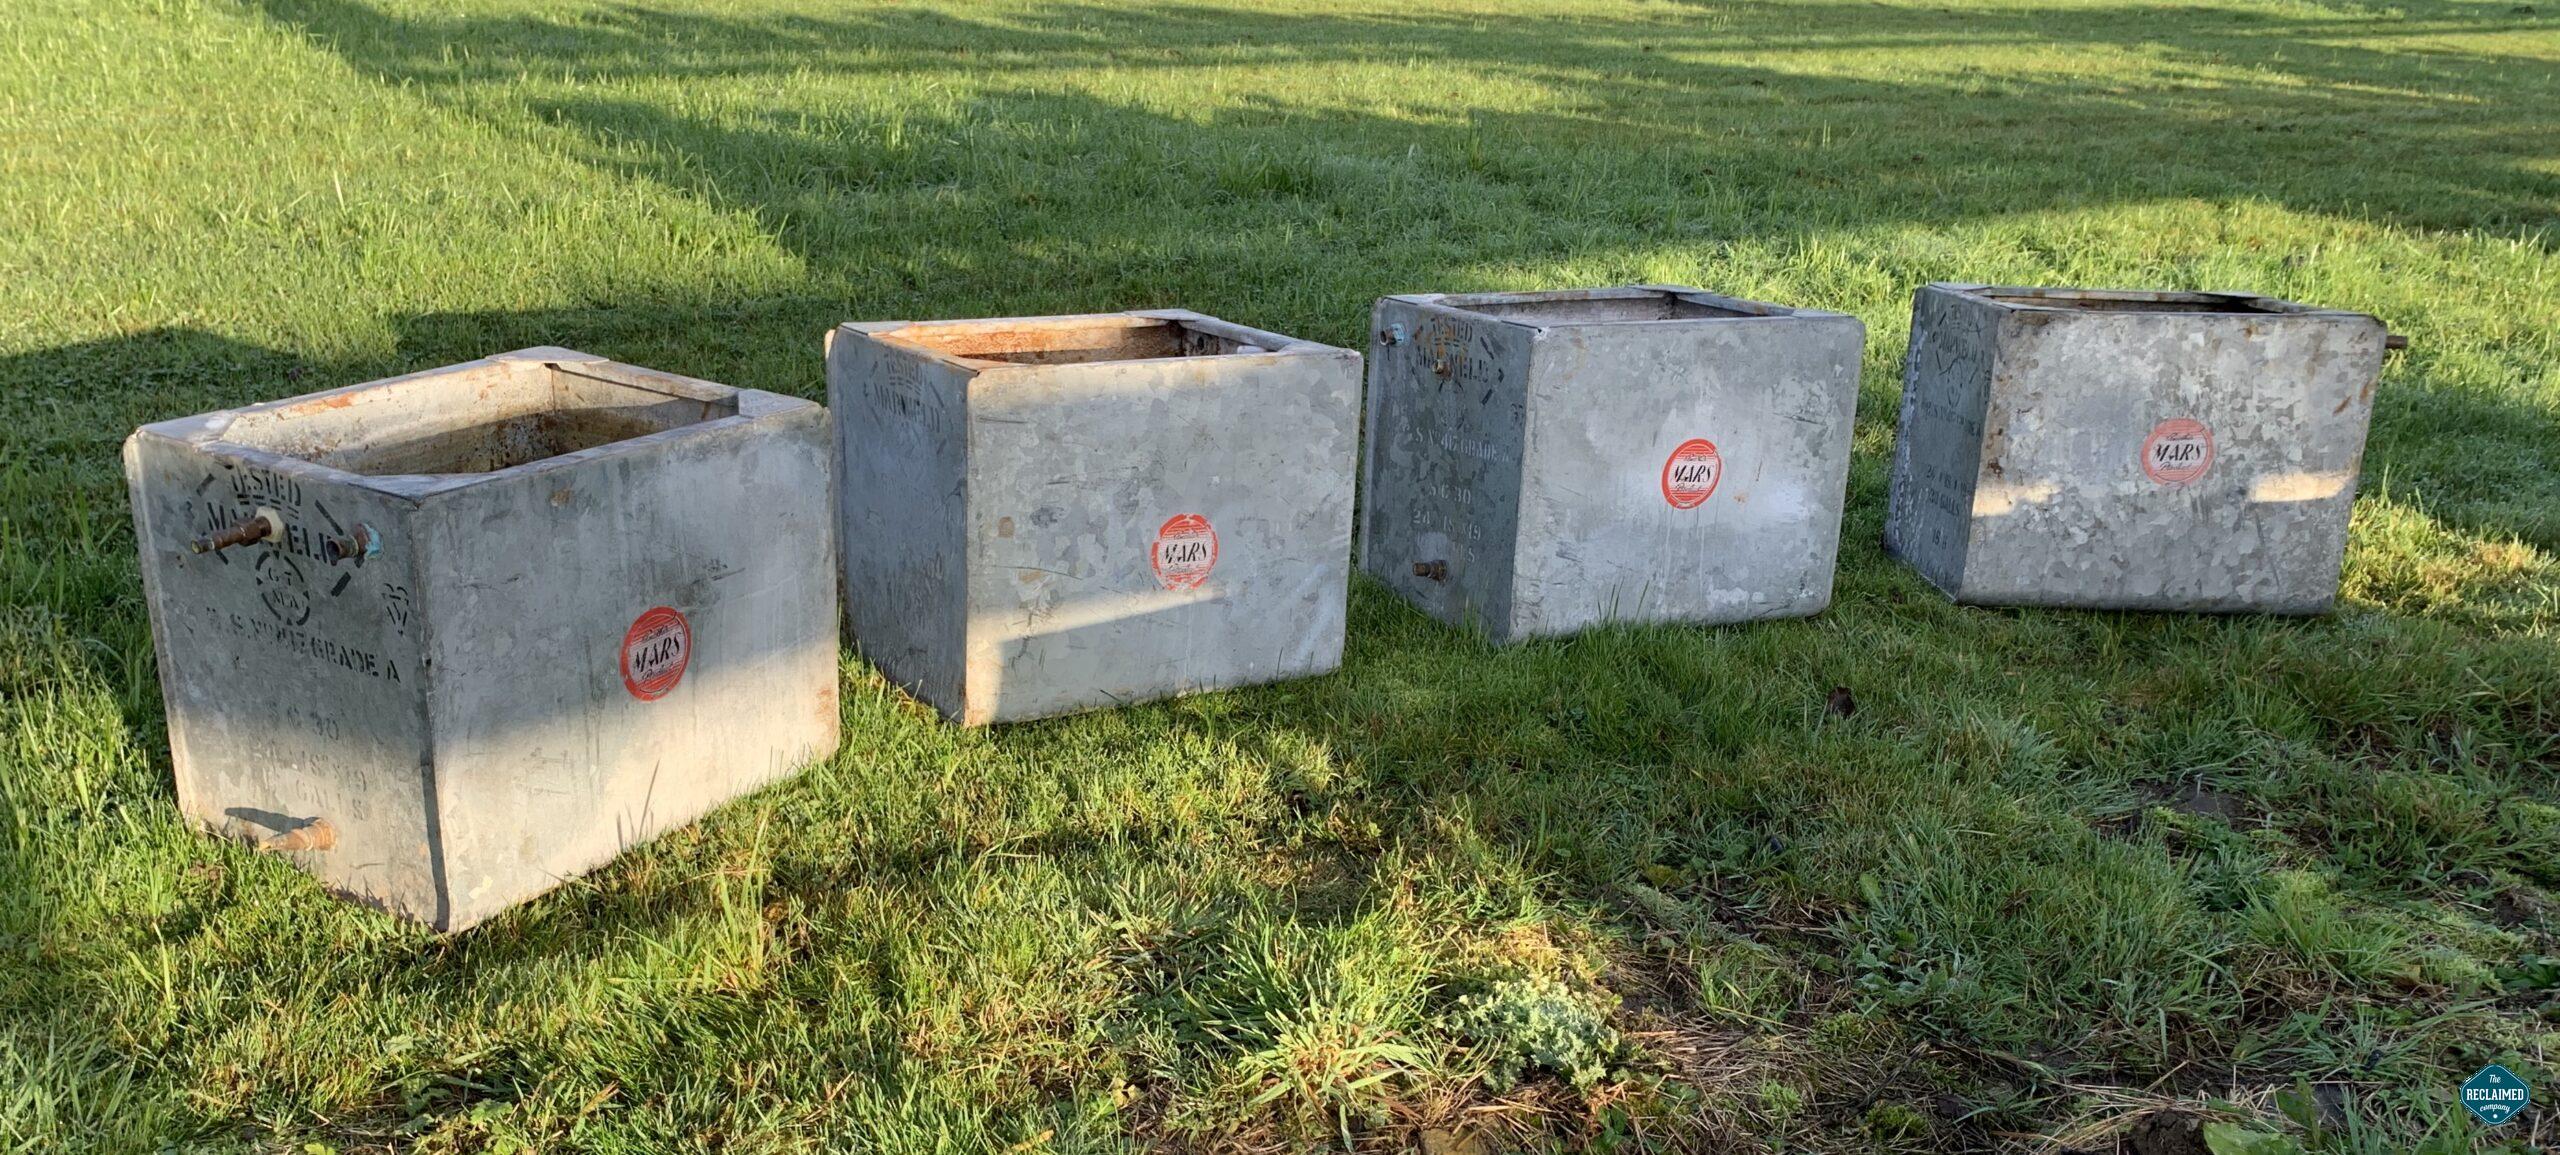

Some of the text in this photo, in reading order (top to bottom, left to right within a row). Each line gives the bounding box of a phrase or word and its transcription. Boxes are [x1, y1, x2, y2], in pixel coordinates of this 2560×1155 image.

[2153, 443, 2201, 462] MARS
[230, 467, 302, 507] TESTED
[1673, 464, 1711, 483] MARS
[1164, 542, 1207, 564] MARS
[310, 636, 379, 677] GRADE
[386, 659, 401, 683] A
[634, 633, 681, 674] MARS
